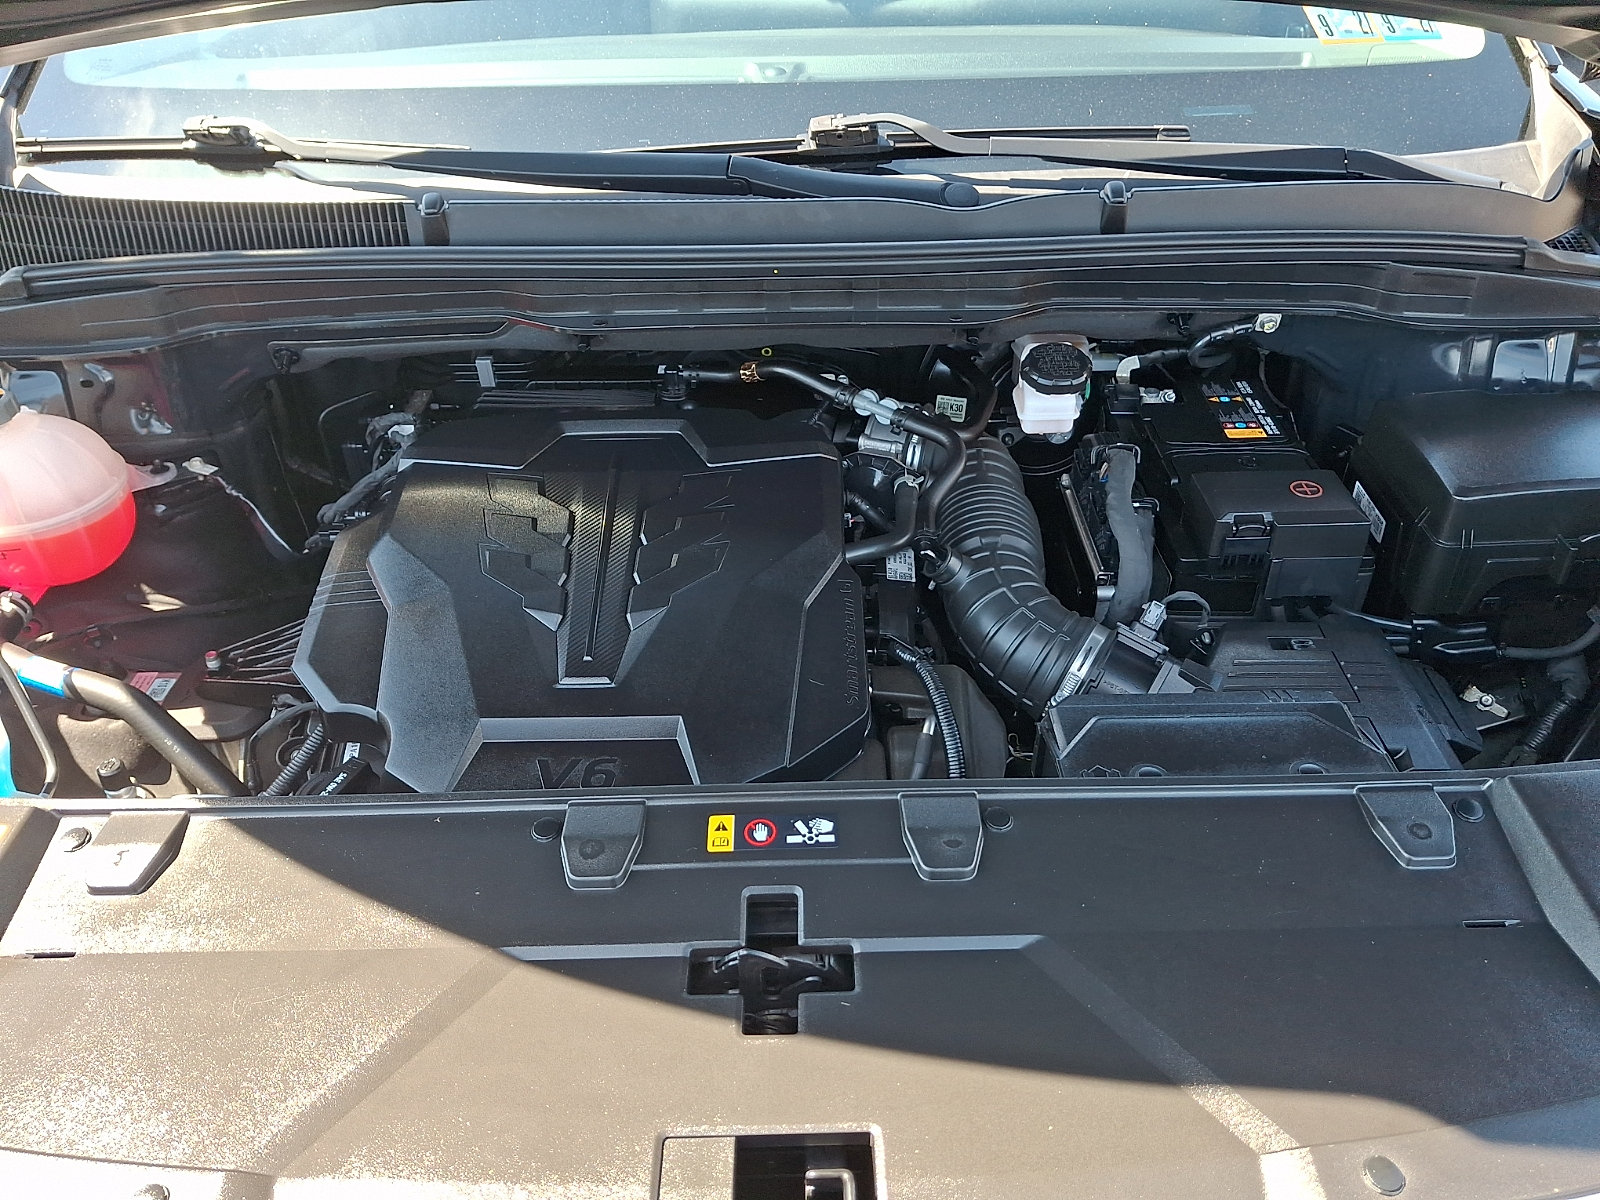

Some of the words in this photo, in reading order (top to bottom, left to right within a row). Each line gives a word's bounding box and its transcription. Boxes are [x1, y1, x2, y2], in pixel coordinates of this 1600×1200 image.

[1317, 13, 1334, 37] 9
[950, 402, 964, 413] K30
[536, 756, 619, 789] V6
